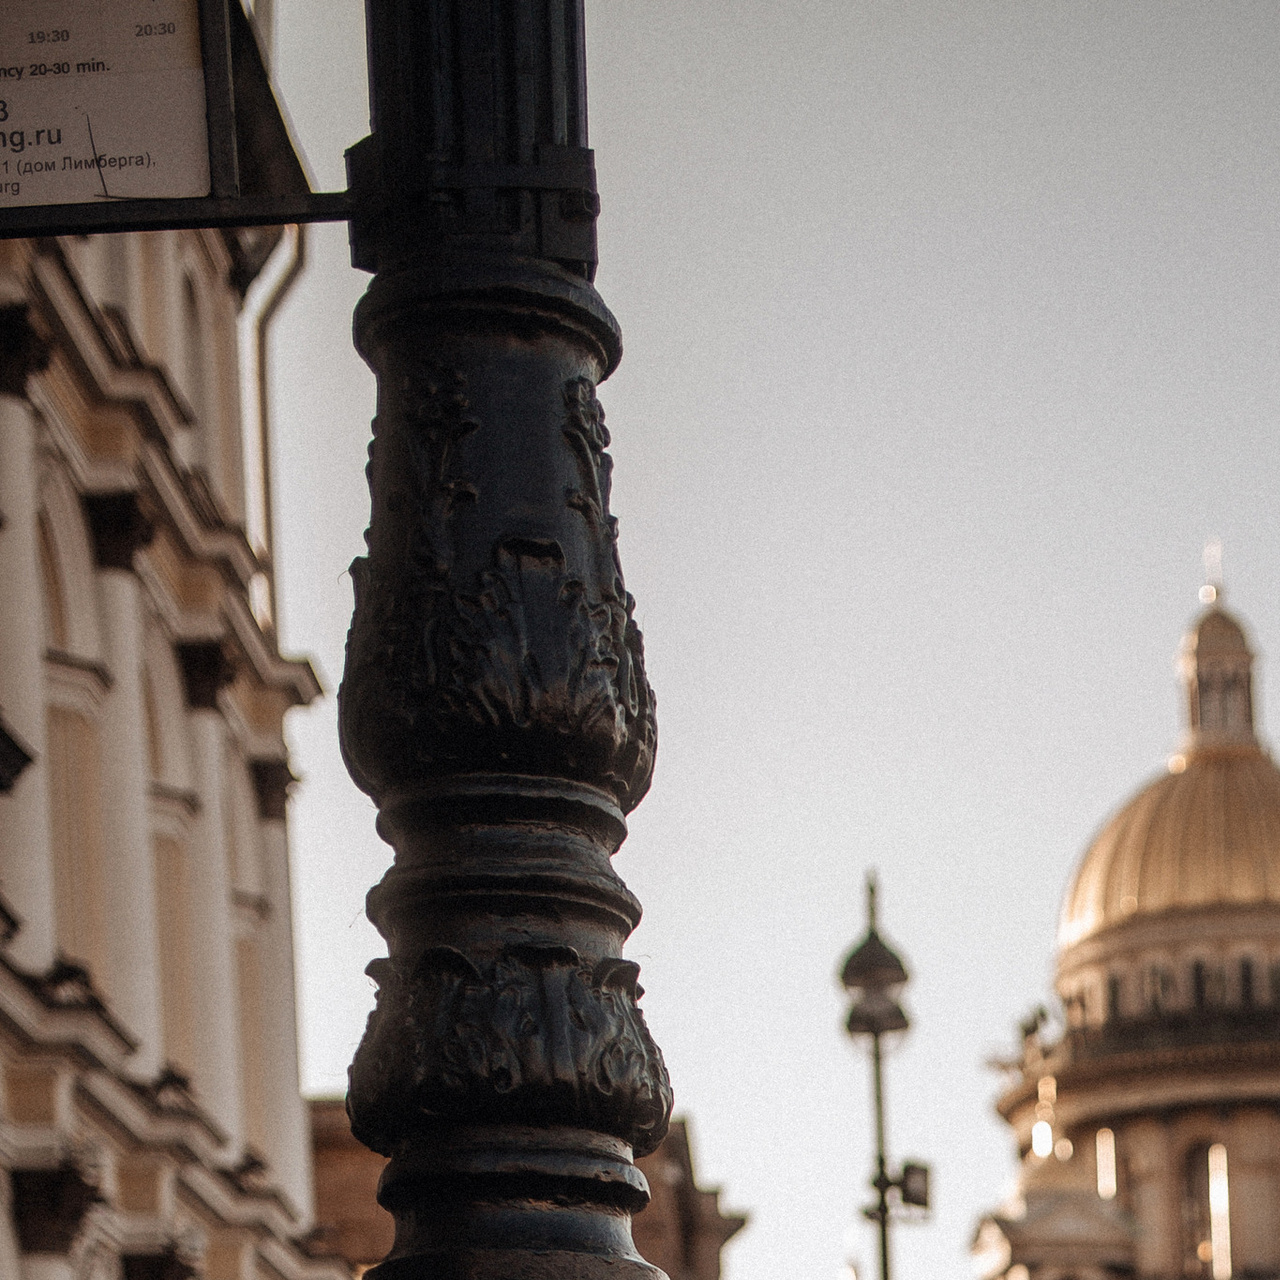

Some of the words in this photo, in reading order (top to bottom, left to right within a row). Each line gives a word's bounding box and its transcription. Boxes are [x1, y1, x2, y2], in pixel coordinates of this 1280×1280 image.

[28, 30, 70, 44] 19:30
[135, 23, 176, 37] 20:30
[30, 62, 70, 76] 20-30
[77, 58, 110, 73] min.
[17, 159, 56, 176] (дом
[61, 151, 156, 171] Лимберга),
